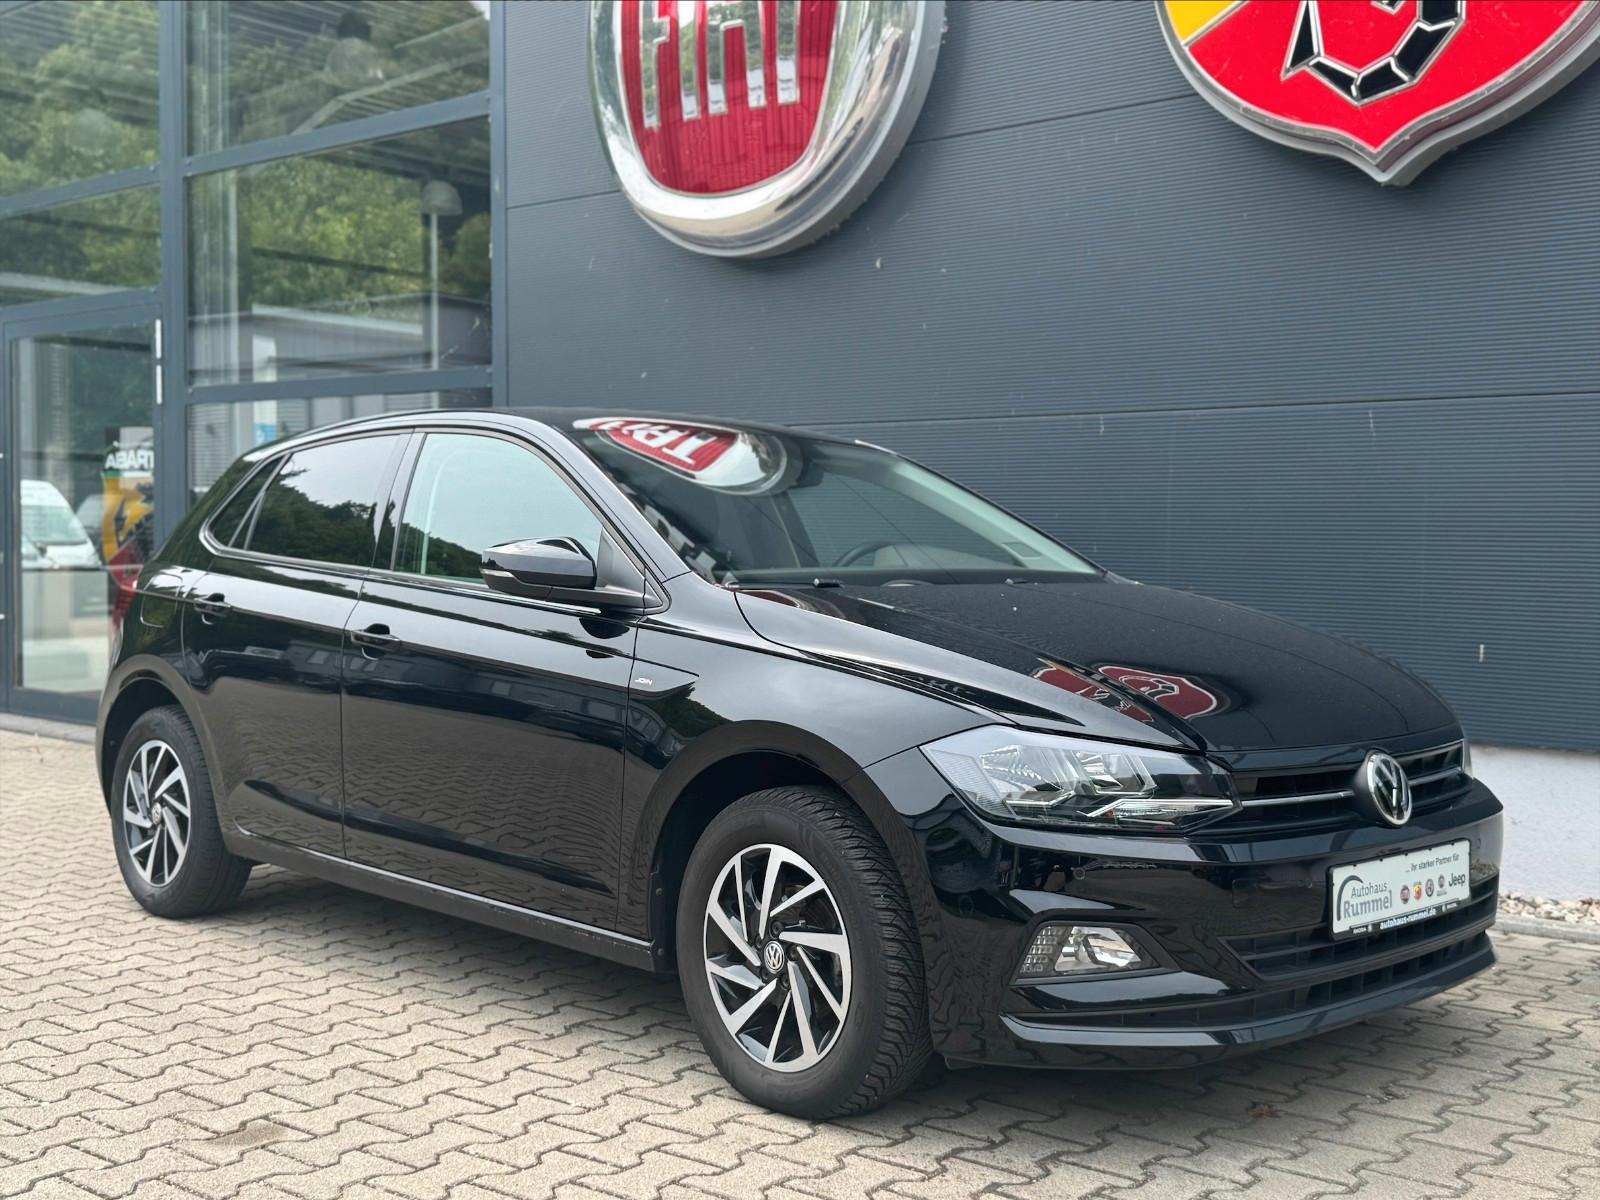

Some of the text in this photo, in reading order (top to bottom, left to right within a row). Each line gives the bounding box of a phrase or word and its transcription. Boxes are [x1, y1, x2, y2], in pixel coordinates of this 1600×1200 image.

[1435, 855, 1452, 866] Partner
[1448, 872, 1466, 887] Jeep
[1351, 882, 1388, 899] Autohaus
[1343, 889, 1393, 919] Rummel
[1380, 907, 1436, 930] autohaus-rummel.de
